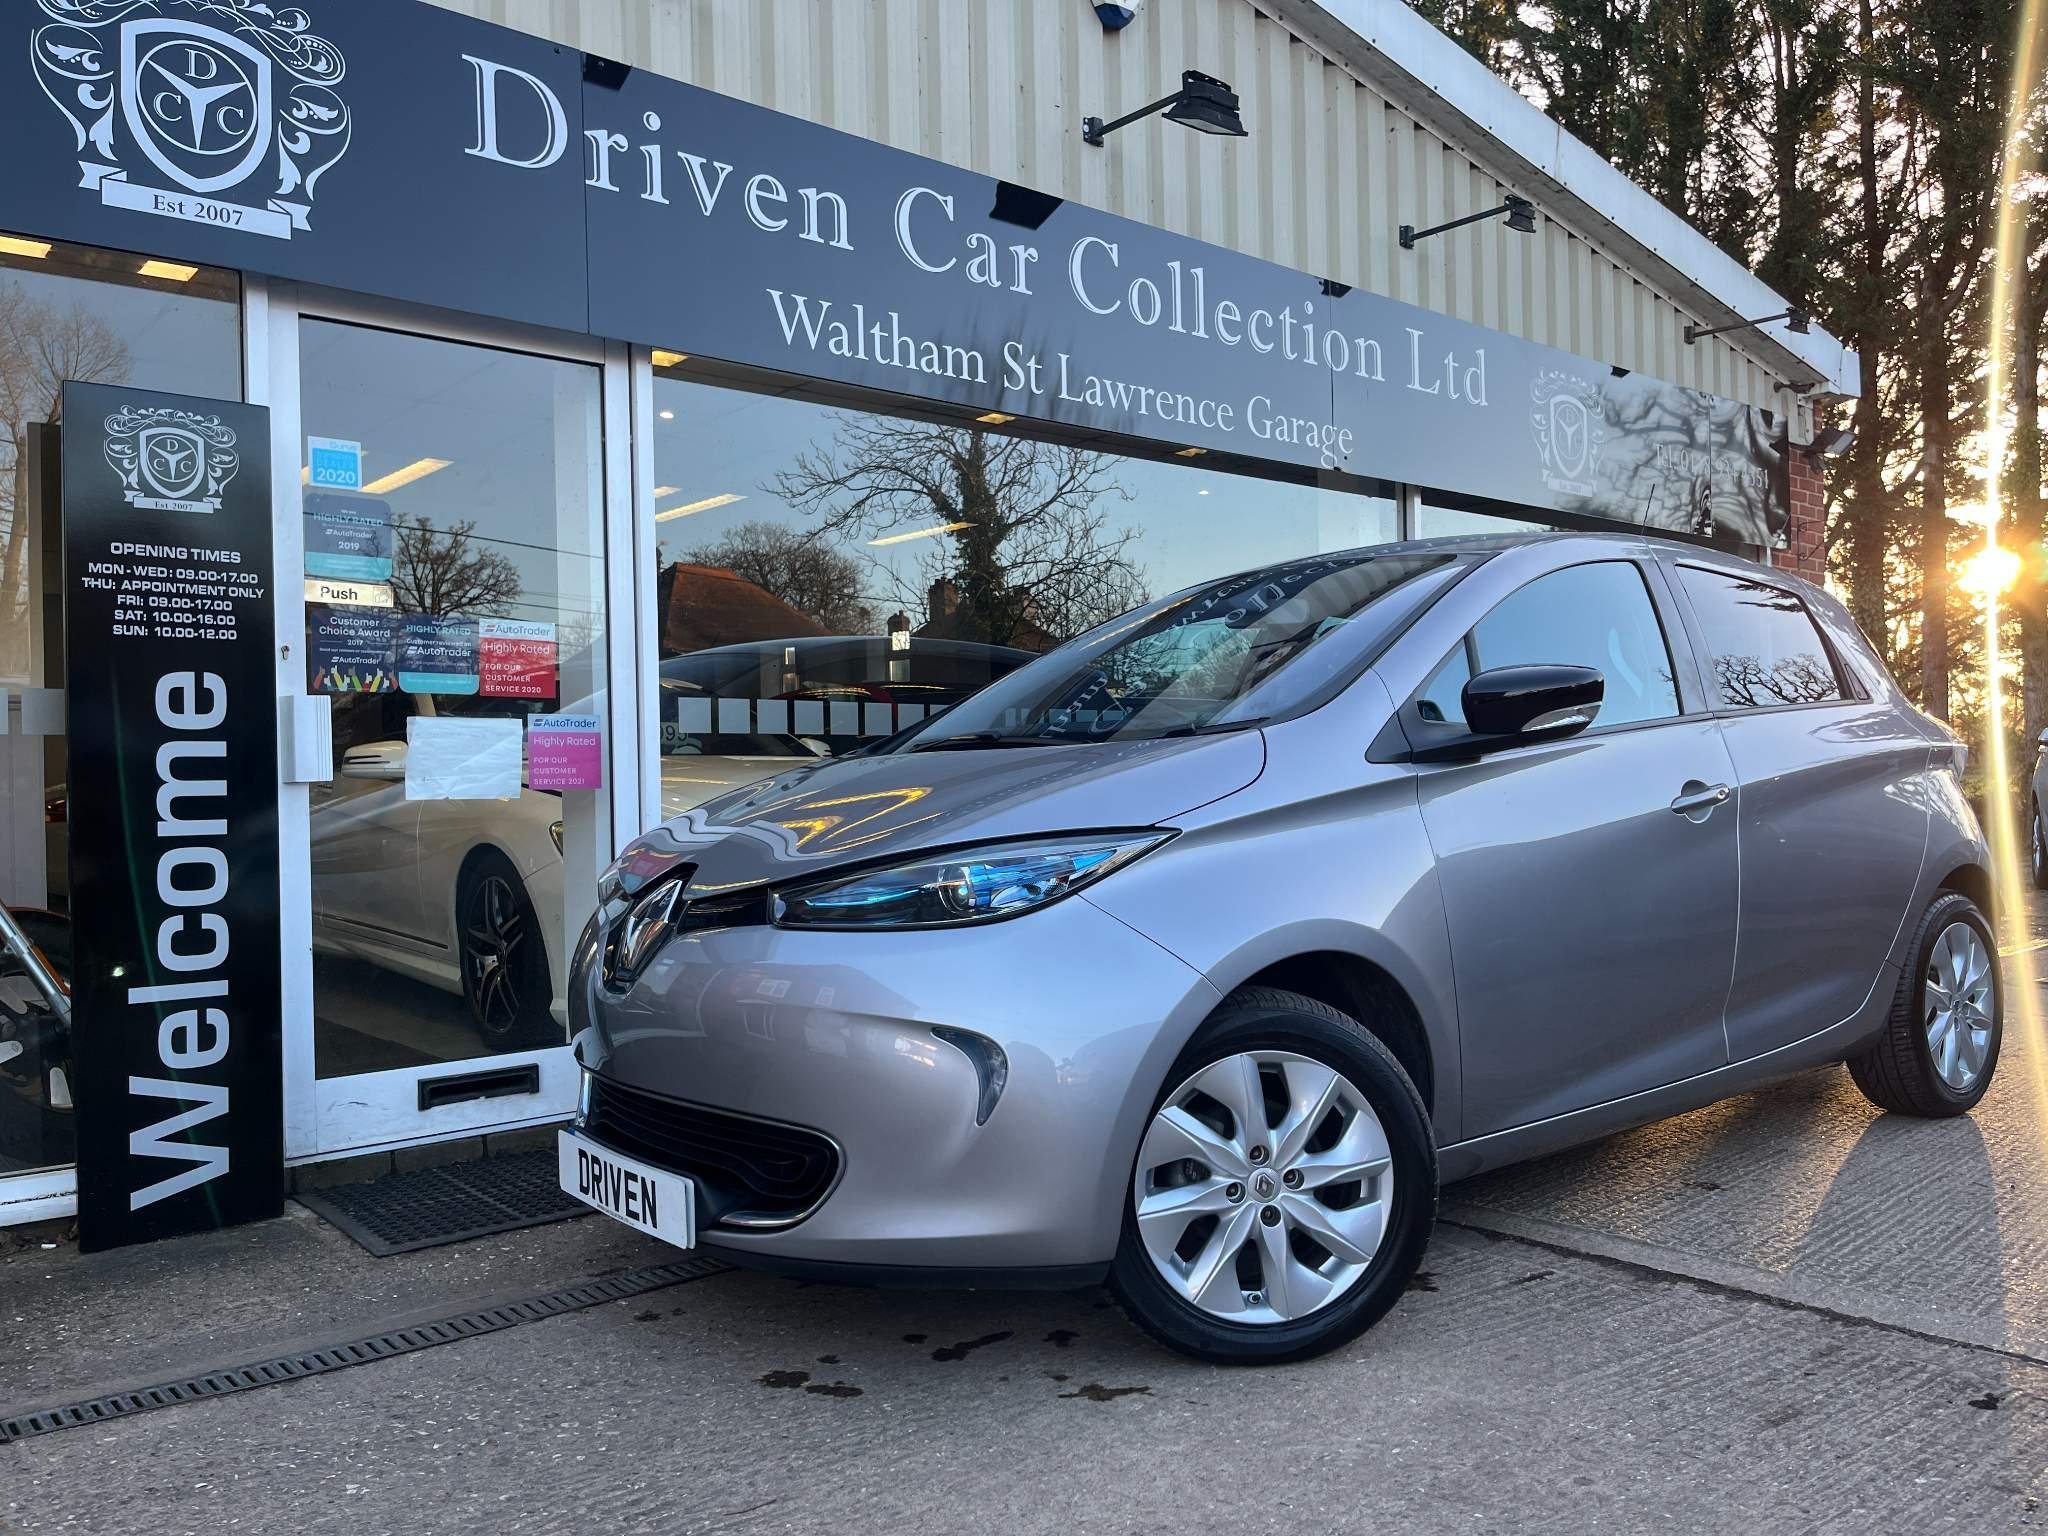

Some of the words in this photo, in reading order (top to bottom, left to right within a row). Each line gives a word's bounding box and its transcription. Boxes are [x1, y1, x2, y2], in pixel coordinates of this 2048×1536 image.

[185, 48, 217, 80] D
[153, 92, 183, 122] C
[216, 106, 246, 135] C
[153, 194, 186, 215] Est
[194, 202, 243, 226] 2007
[461, 53, 854, 251] Driven
[894, 186, 1039, 295] Car
[1068, 236, 1386, 381] Collection
[1405, 327, 1490, 407] Ltd
[766, 288, 987, 383] Waltham
[1003, 341, 1044, 395] St
[1057, 352, 1235, 432] Lawrence
[1246, 395, 1354, 470] Garage
[166, 438, 179, 451] D
[153, 457, 166, 471] C
[180, 460, 192, 473] C
[317, 467, 356, 484] 2020
[154, 501, 169, 509] Est
[172, 502, 193, 511] 2007
[313, 511, 350, 523] HIGHLY
[352, 516, 384, 527] RATED
[110, 541, 188, 560] OPENING
[190, 548, 241, 564] TIMES
[338, 541, 360, 551] 2019
[176, 568, 258, 584] 09.00-17.00
[82, 577, 117, 590] THU:
[121, 580, 226, 596] APPOINTMENT
[228, 587, 265, 599] ONLY
[320, 586, 358, 600] Push
[117, 595, 144, 606] FRI:
[148, 596, 233, 611] 09.00-17.00
[114, 610, 147, 622] SAT:
[152, 612, 236, 626] 10.00-16.00
[330, 616, 380, 627] Customer
[113, 625, 148, 637] SUN:
[154, 626, 237, 641] 10.00-12.00
[319, 626, 355, 636] Choice
[357, 629, 391, 638] Award
[406, 625, 440, 634] HIGHLY
[442, 627, 471, 636] RATED
[495, 625, 550, 637] AutoTrader
[417, 646, 472, 657] AutoTrader
[485, 644, 518, 656] Highly
[520, 645, 550, 655] Rated
[338, 656, 380, 665] AutoTrader
[485, 675, 531, 683] CUSTOMER
[485, 685, 520, 693] SERVICE
[522, 686, 542, 694] 2020
[543, 719, 597, 729] AutoTrader
[533, 736, 565, 748] Highly
[567, 736, 596, 747] Rated
[533, 756, 549, 764] FOR
[551, 757, 568, 765] OUR
[533, 767, 577, 775] CUSTOMER
[534, 778, 566, 786] SERVICE
[568, 778, 585, 786] 2021
[127, 671, 229, 1212] Welcome
[578, 1148, 658, 1230] DRIVEN
